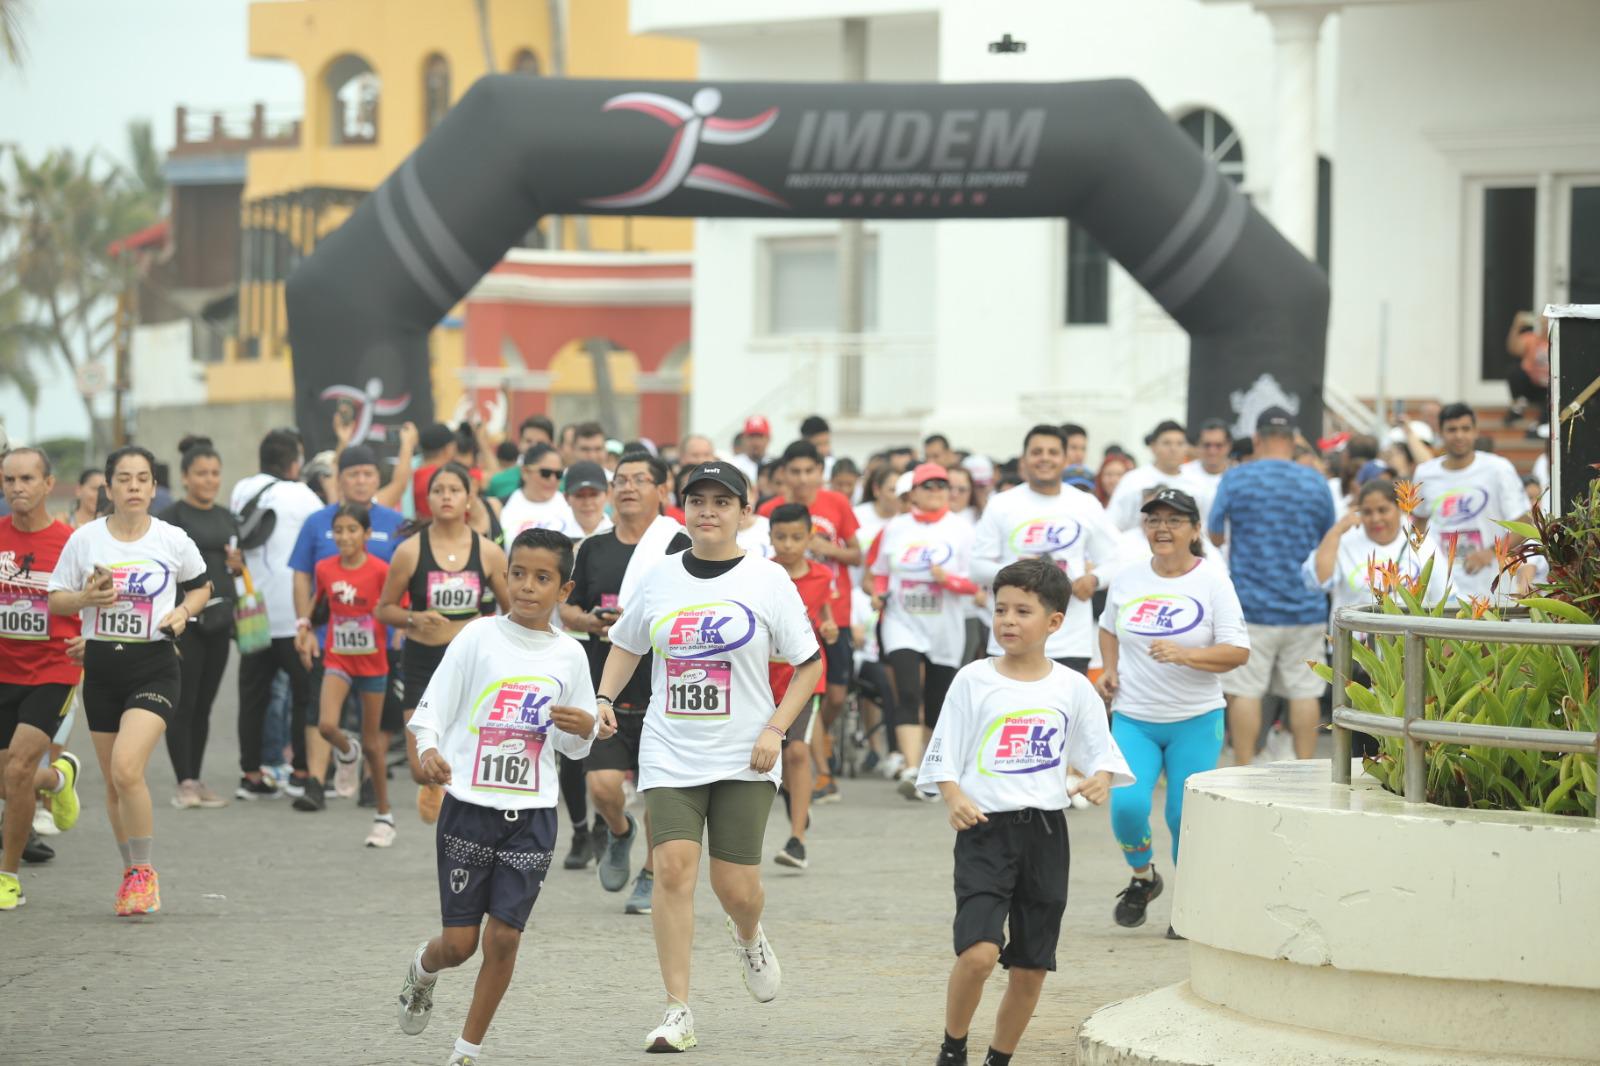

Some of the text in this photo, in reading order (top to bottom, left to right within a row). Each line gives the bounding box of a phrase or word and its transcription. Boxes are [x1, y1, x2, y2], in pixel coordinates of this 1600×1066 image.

[788, 108, 1048, 171] IMDEM
[785, 172, 858, 189] INSTITUTO
[1024, 526, 1066, 544] 5K
[434, 589, 473, 607] 1097
[0, 611, 45, 632] 1065
[101, 612, 142, 635] 1135
[1129, 603, 1184, 628] 5K
[335, 631, 368, 647] 1145
[668, 616, 733, 645] 5K
[680, 629, 717, 645] DIF
[488, 689, 552, 726] 5K
[670, 684, 719, 711] 1138
[501, 705, 538, 724] DIF
[995, 725, 1058, 759] 5K
[1009, 740, 1047, 758] DIF
[481, 754, 530, 785] 1162
